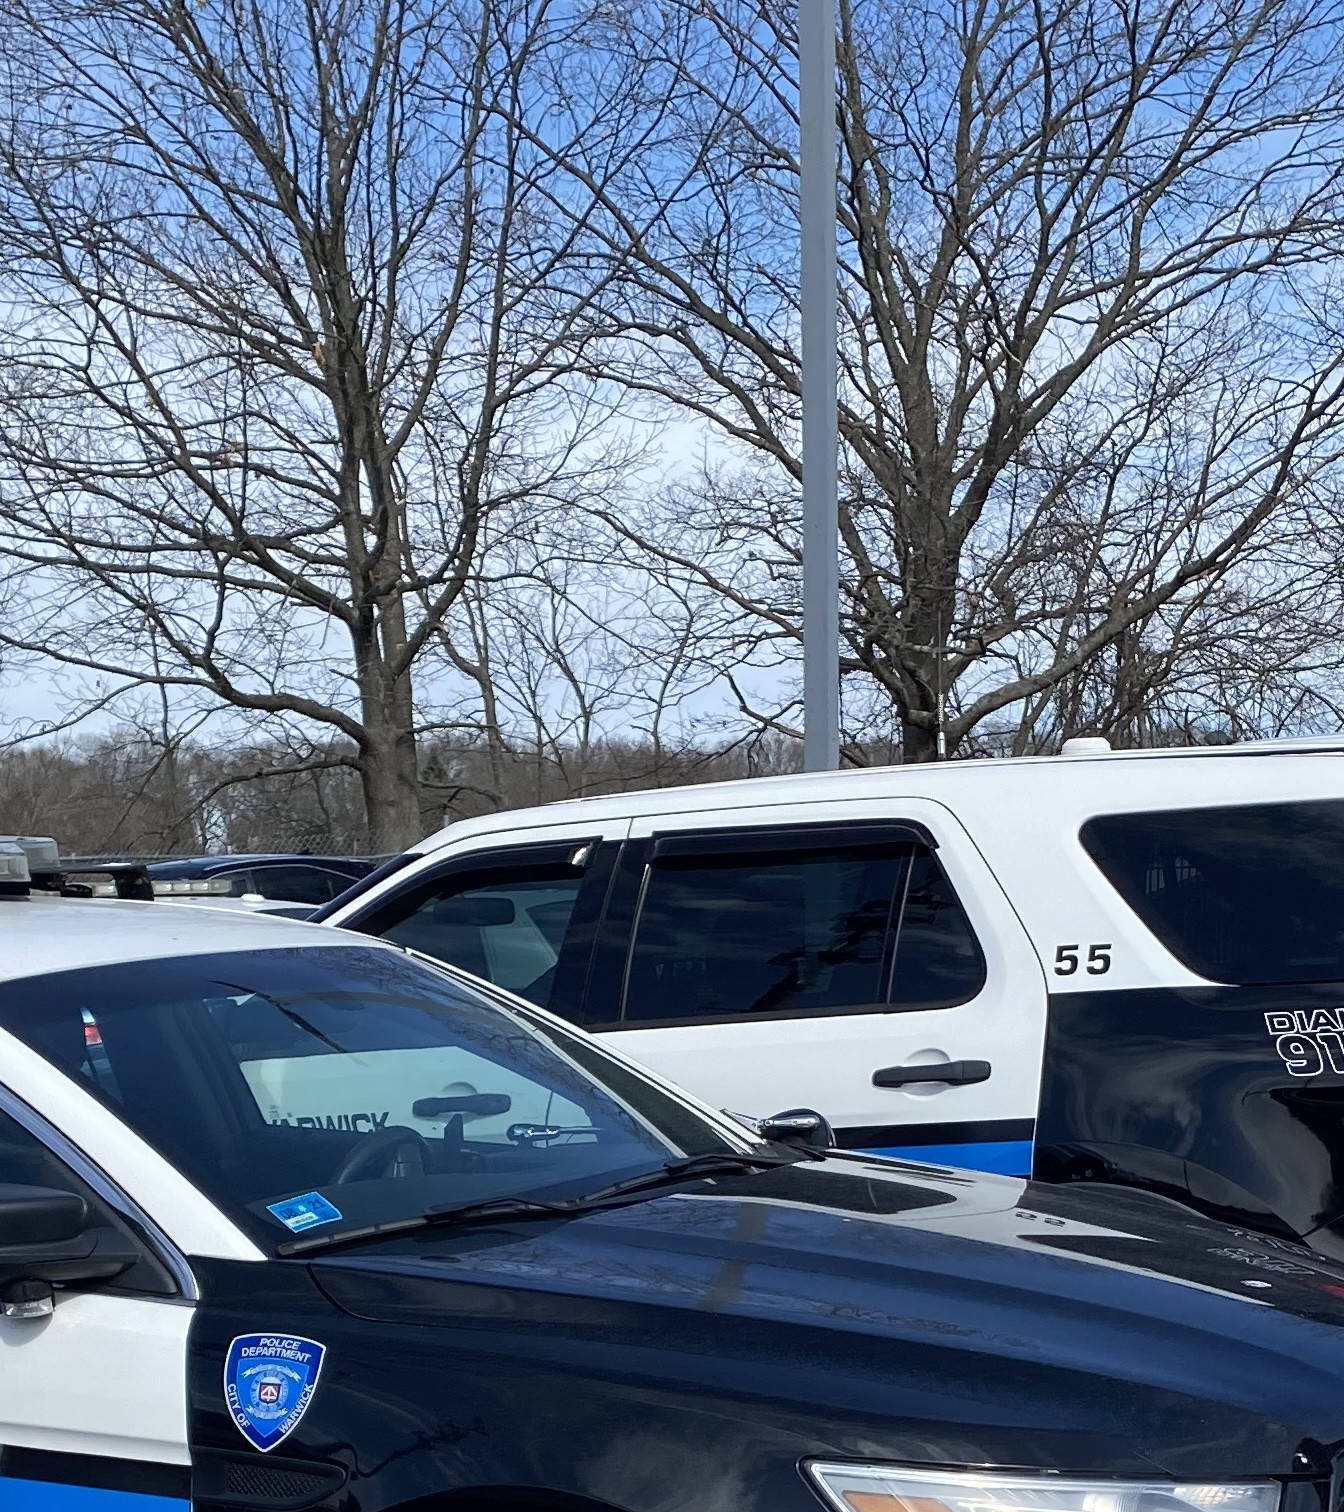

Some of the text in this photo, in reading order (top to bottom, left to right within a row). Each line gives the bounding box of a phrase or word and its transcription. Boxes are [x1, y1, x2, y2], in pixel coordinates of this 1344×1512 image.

[1053, 943, 1113, 976] 55
[241, 1346, 312, 1363] DEPARTMENT
[259, 1337, 302, 1350] POLICE
[227, 1383, 241, 1410] CITY
[236, 1413, 251, 1429] OF
[277, 1383, 315, 1434] WARWICK
